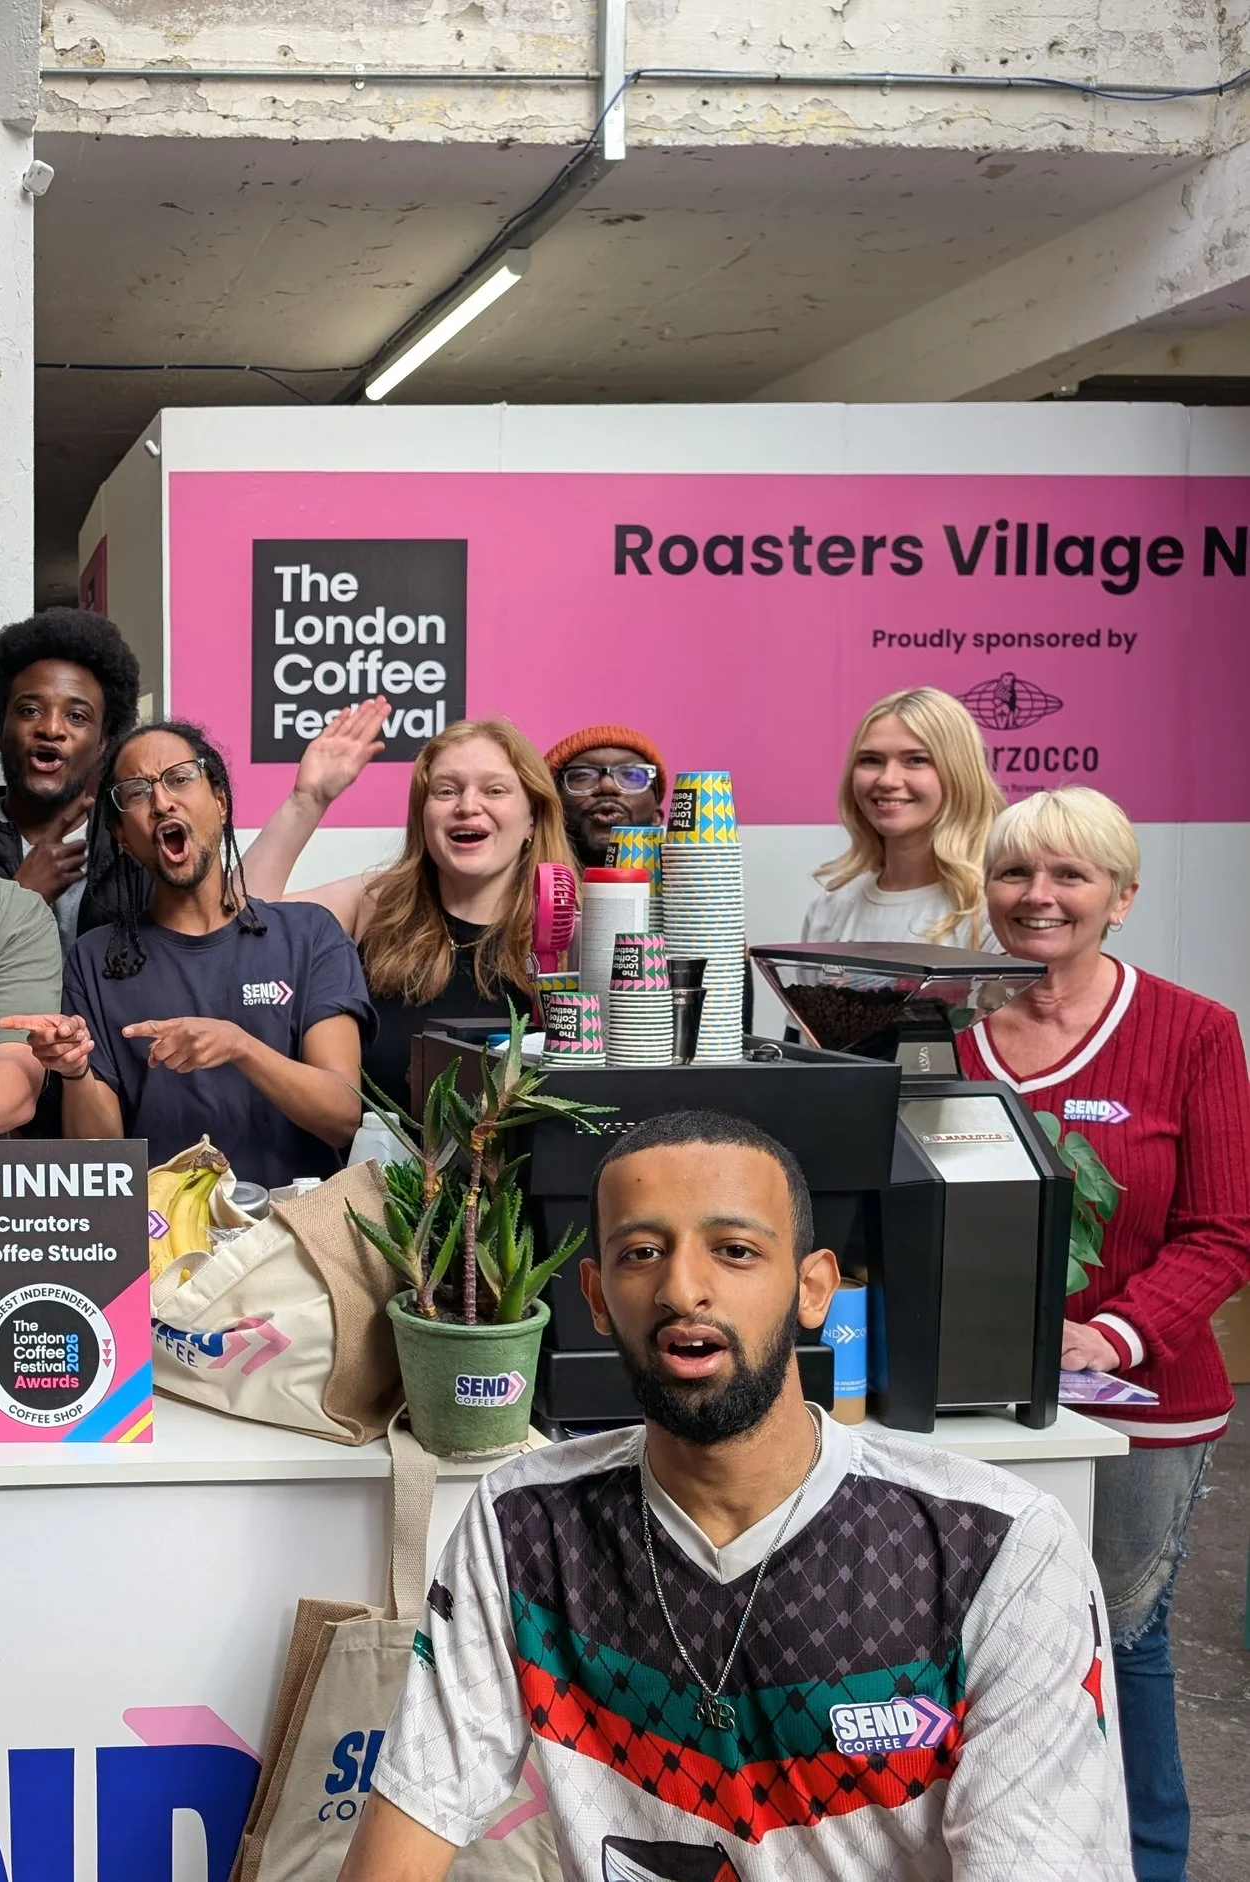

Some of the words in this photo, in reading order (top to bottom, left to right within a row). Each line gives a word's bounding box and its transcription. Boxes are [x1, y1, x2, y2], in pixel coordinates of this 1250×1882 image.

[614, 524, 924, 577] Roasters
[943, 518, 1184, 596] Village
[1203, 526, 1248, 577] N
[274, 563, 359, 603] The
[274, 606, 447, 646] London
[872, 628, 966, 655] Proudly
[972, 628, 1101, 655] sponsored
[1107, 628, 1138, 655] by
[273, 649, 448, 695] Coffee
[273, 700, 446, 740] Feval
[984, 746, 1099, 772] rzocco
[673, 820, 690, 828] The
[622, 970, 639, 978] The
[242, 982, 279, 999] SEND
[243, 998, 270, 1006] COFFEE
[559, 1031, 577, 1039] The
[1064, 1099, 1111, 1116] SEND
[48, 1243, 118, 1262] Studio
[20, 1288, 98, 1318] INDEPENDENT
[13, 1320, 38, 1332] The
[13, 1332, 65, 1345] London
[13, 1346, 66, 1360] Coffee
[66, 1334, 79, 1372] 2026
[13, 1360, 66, 1373] Festival
[14, 1374, 80, 1388] Awards
[456, 1376, 510, 1398] SEND
[456, 1396, 495, 1406] COFFEE
[8, 1404, 50, 1424] COFFEE
[54, 1404, 84, 1422] SHOP
[836, 1704, 918, 1740] SEND
[843, 1738, 902, 1753] COFFEE
